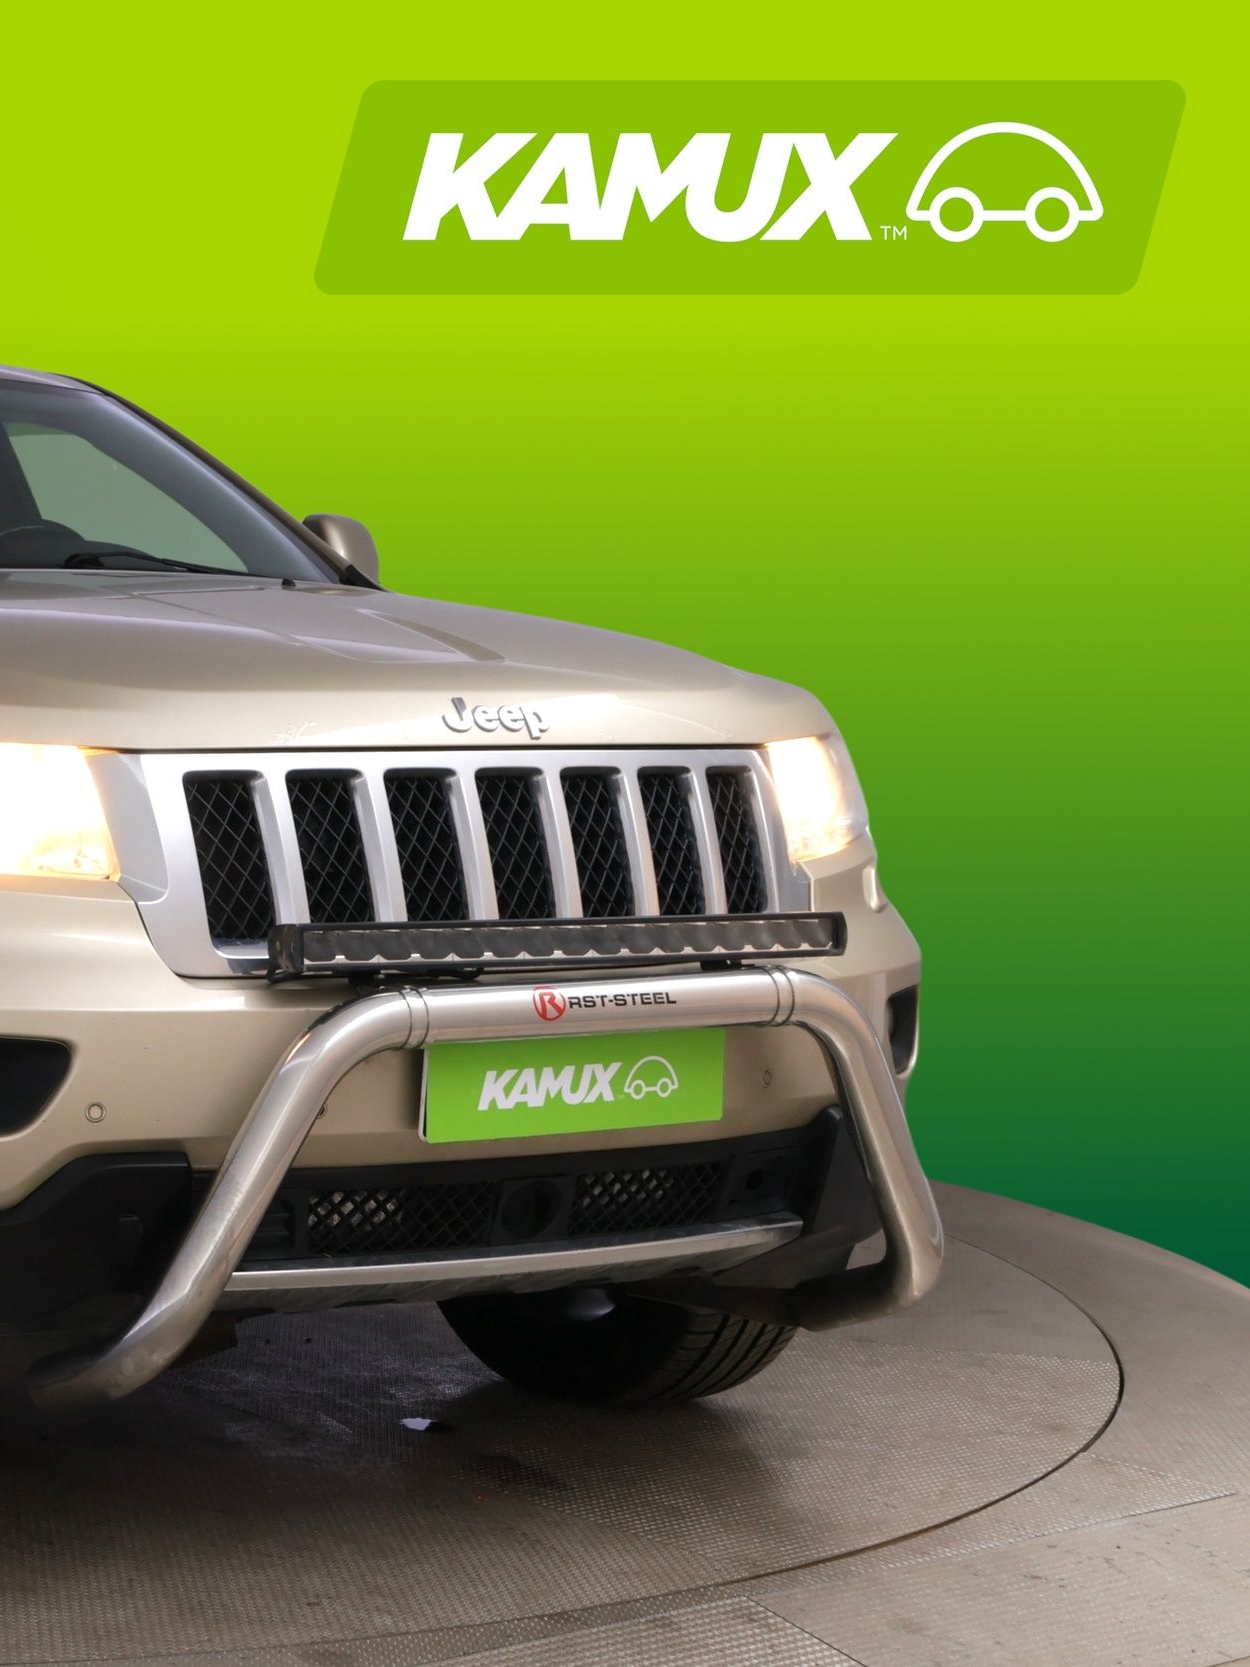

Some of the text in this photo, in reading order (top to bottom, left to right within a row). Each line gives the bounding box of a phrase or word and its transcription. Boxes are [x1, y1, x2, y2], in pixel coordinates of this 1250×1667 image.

[441, 696, 551, 740] Jeep
[568, 991, 678, 1009] RST-STEEL
[477, 1062, 623, 1111] KAMUX
